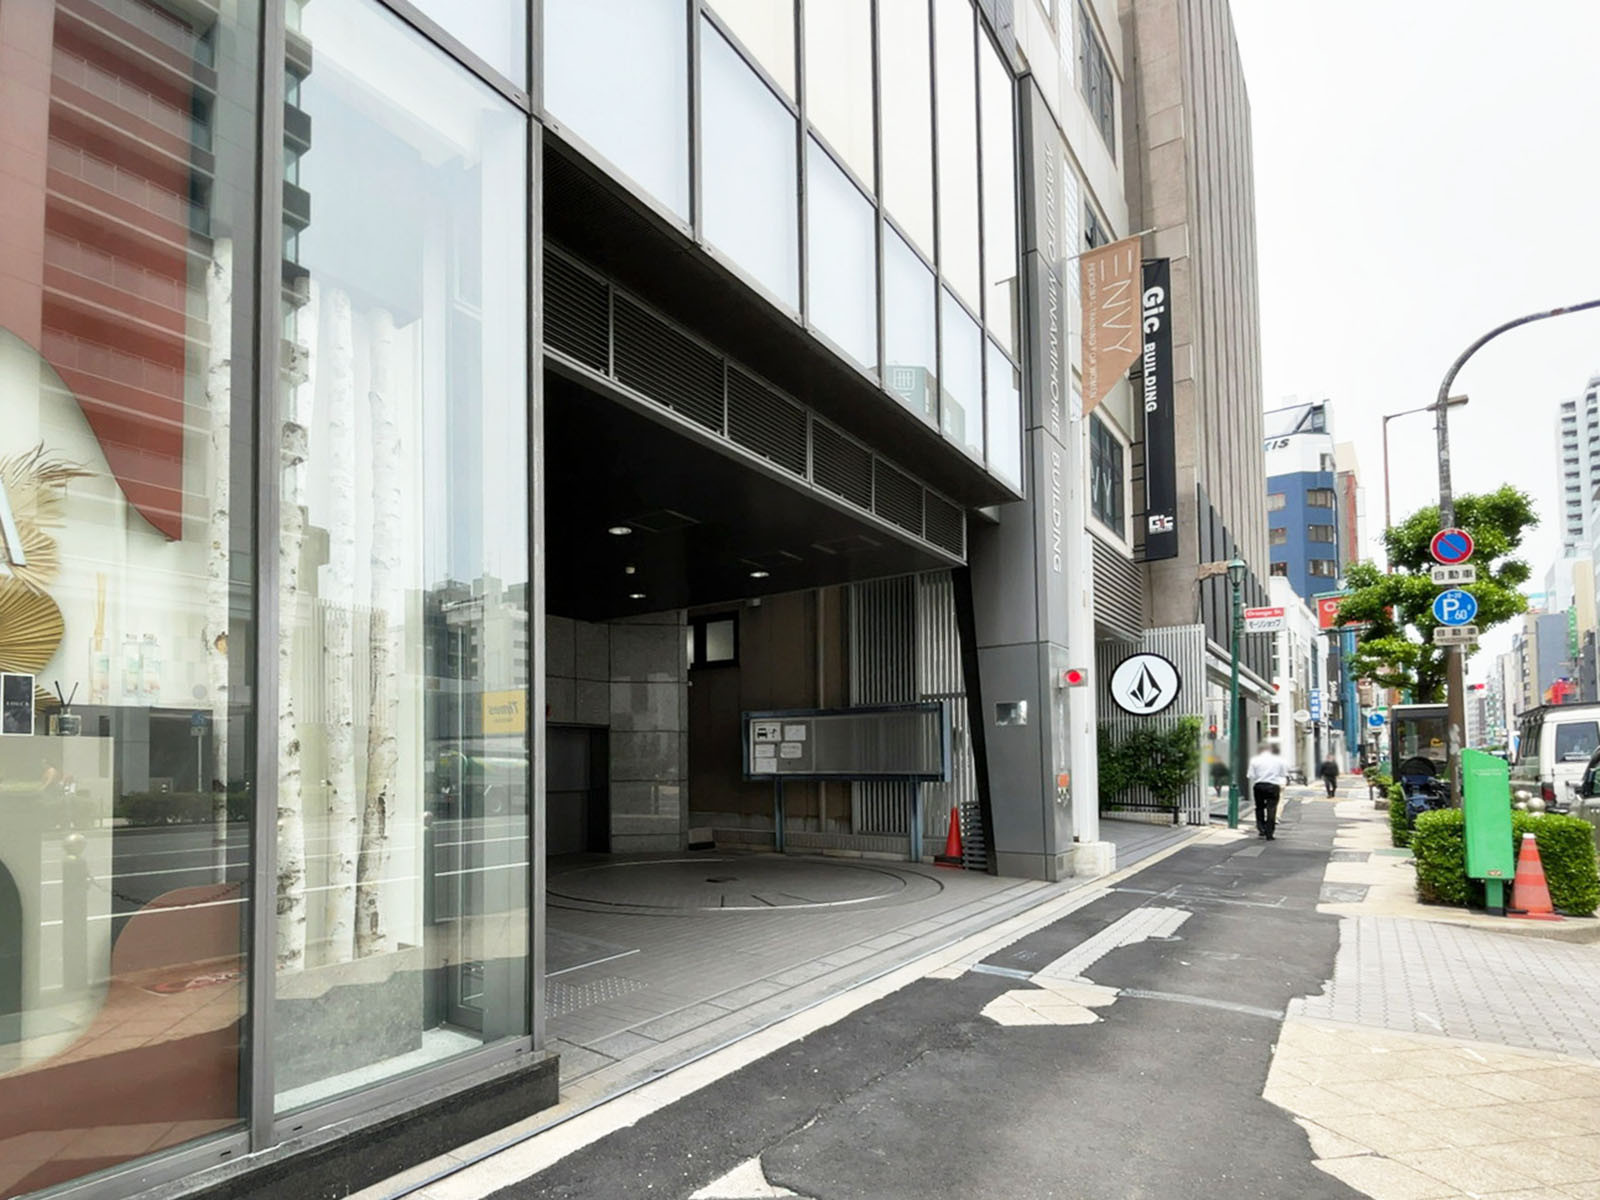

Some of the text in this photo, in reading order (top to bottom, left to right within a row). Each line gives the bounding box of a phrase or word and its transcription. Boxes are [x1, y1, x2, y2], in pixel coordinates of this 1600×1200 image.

[1049, 269, 1060, 437] MINAMIHORIE
[1102, 249, 1133, 353] ENVY
[1143, 286, 1165, 413] Gic BUILDING
[1050, 451, 1062, 573] BUILDING
[1434, 569, 1474, 581] 自動車
[1442, 598, 1460, 621] P
